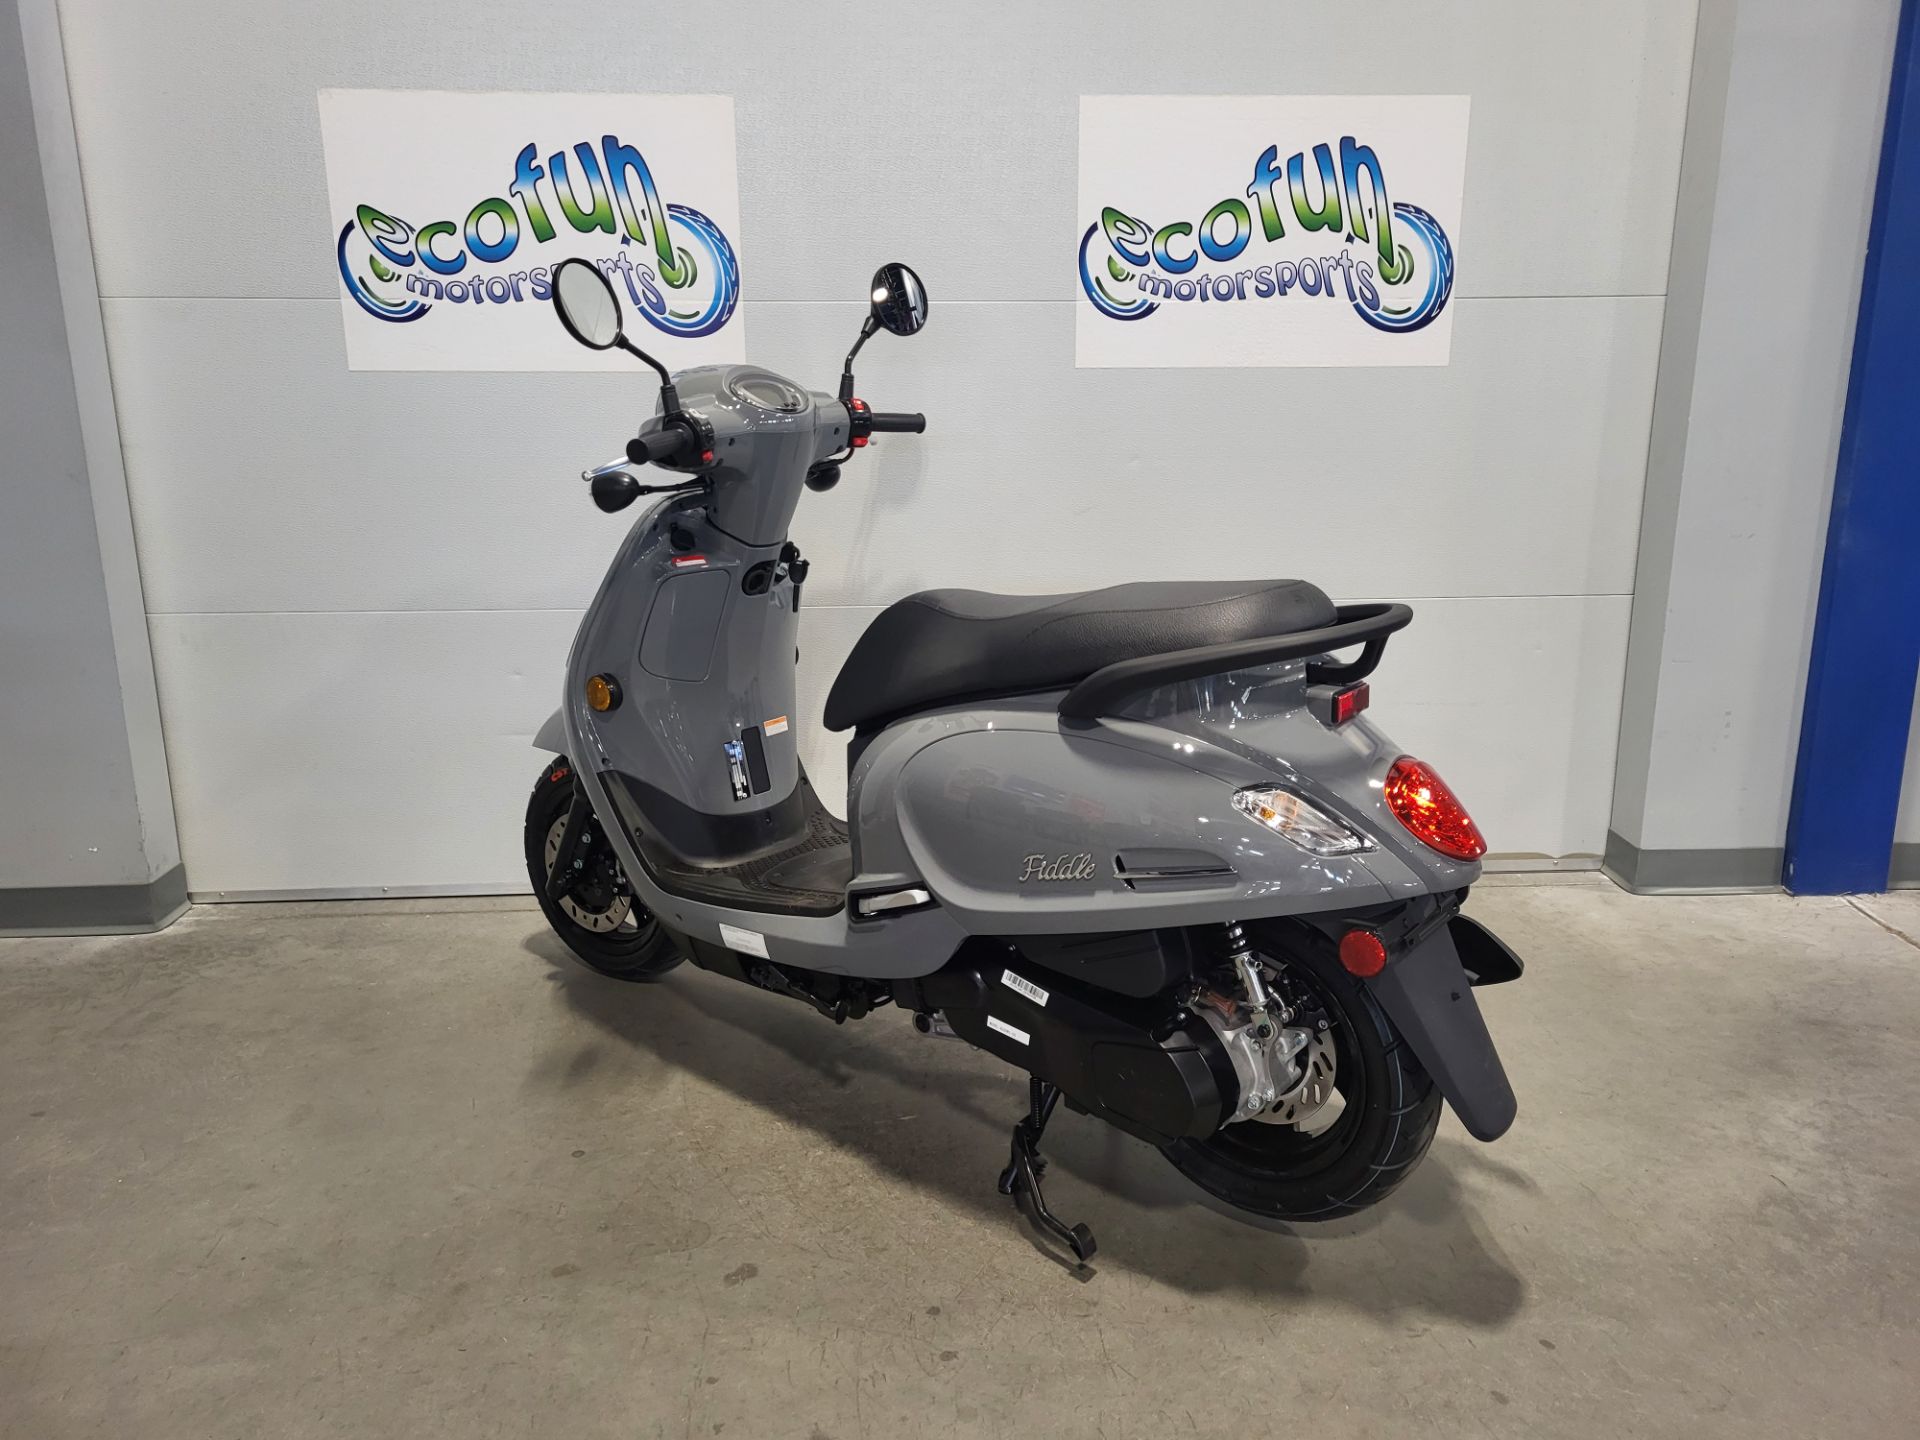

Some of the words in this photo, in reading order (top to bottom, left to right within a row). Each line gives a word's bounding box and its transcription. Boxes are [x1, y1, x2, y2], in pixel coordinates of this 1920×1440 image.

[357, 135, 676, 274] ecofun
[1101, 136, 1394, 274] ecofun
[406, 251, 666, 315] motorsrts
[1138, 250, 1380, 311] motorsports
[1019, 852, 1096, 882] Fiddle
